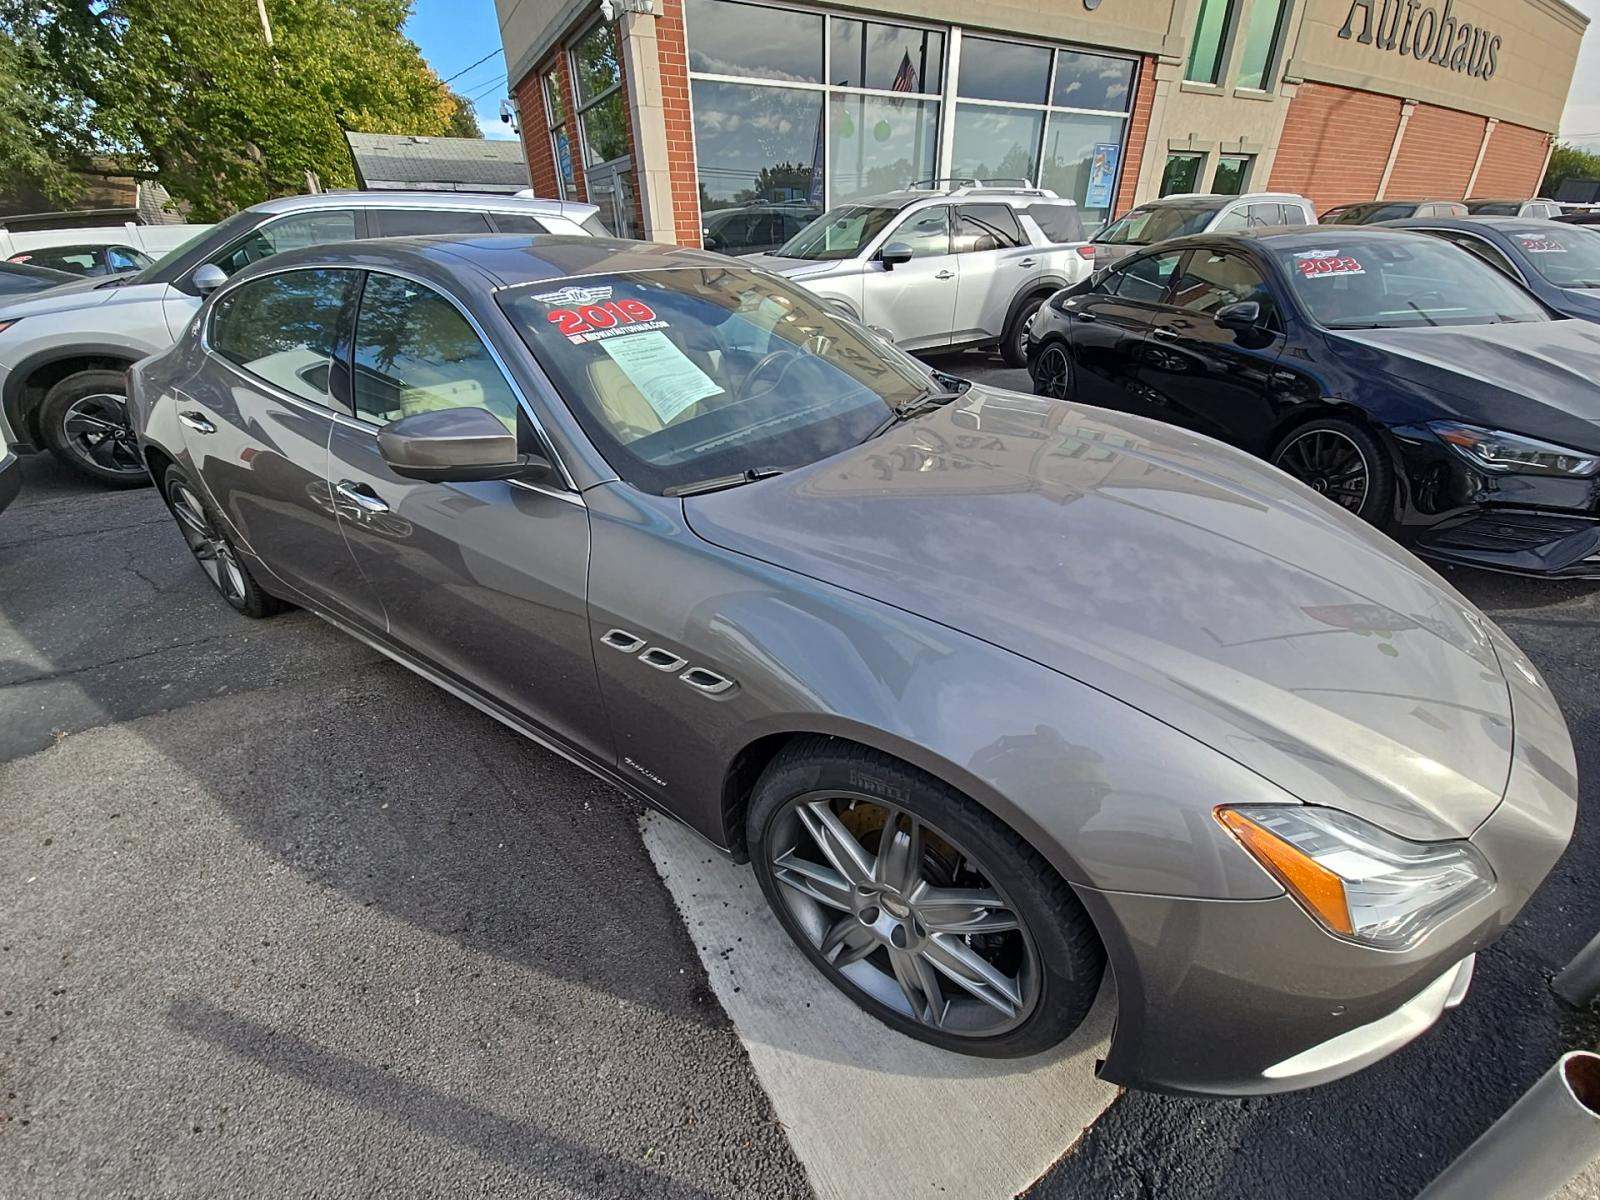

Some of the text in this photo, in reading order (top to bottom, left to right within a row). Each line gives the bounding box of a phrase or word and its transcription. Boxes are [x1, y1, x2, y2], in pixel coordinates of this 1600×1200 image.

[1337, 0, 1502, 81] Autohaus
[1296, 256, 1362, 274] 2023
[549, 298, 656, 337] 2019
